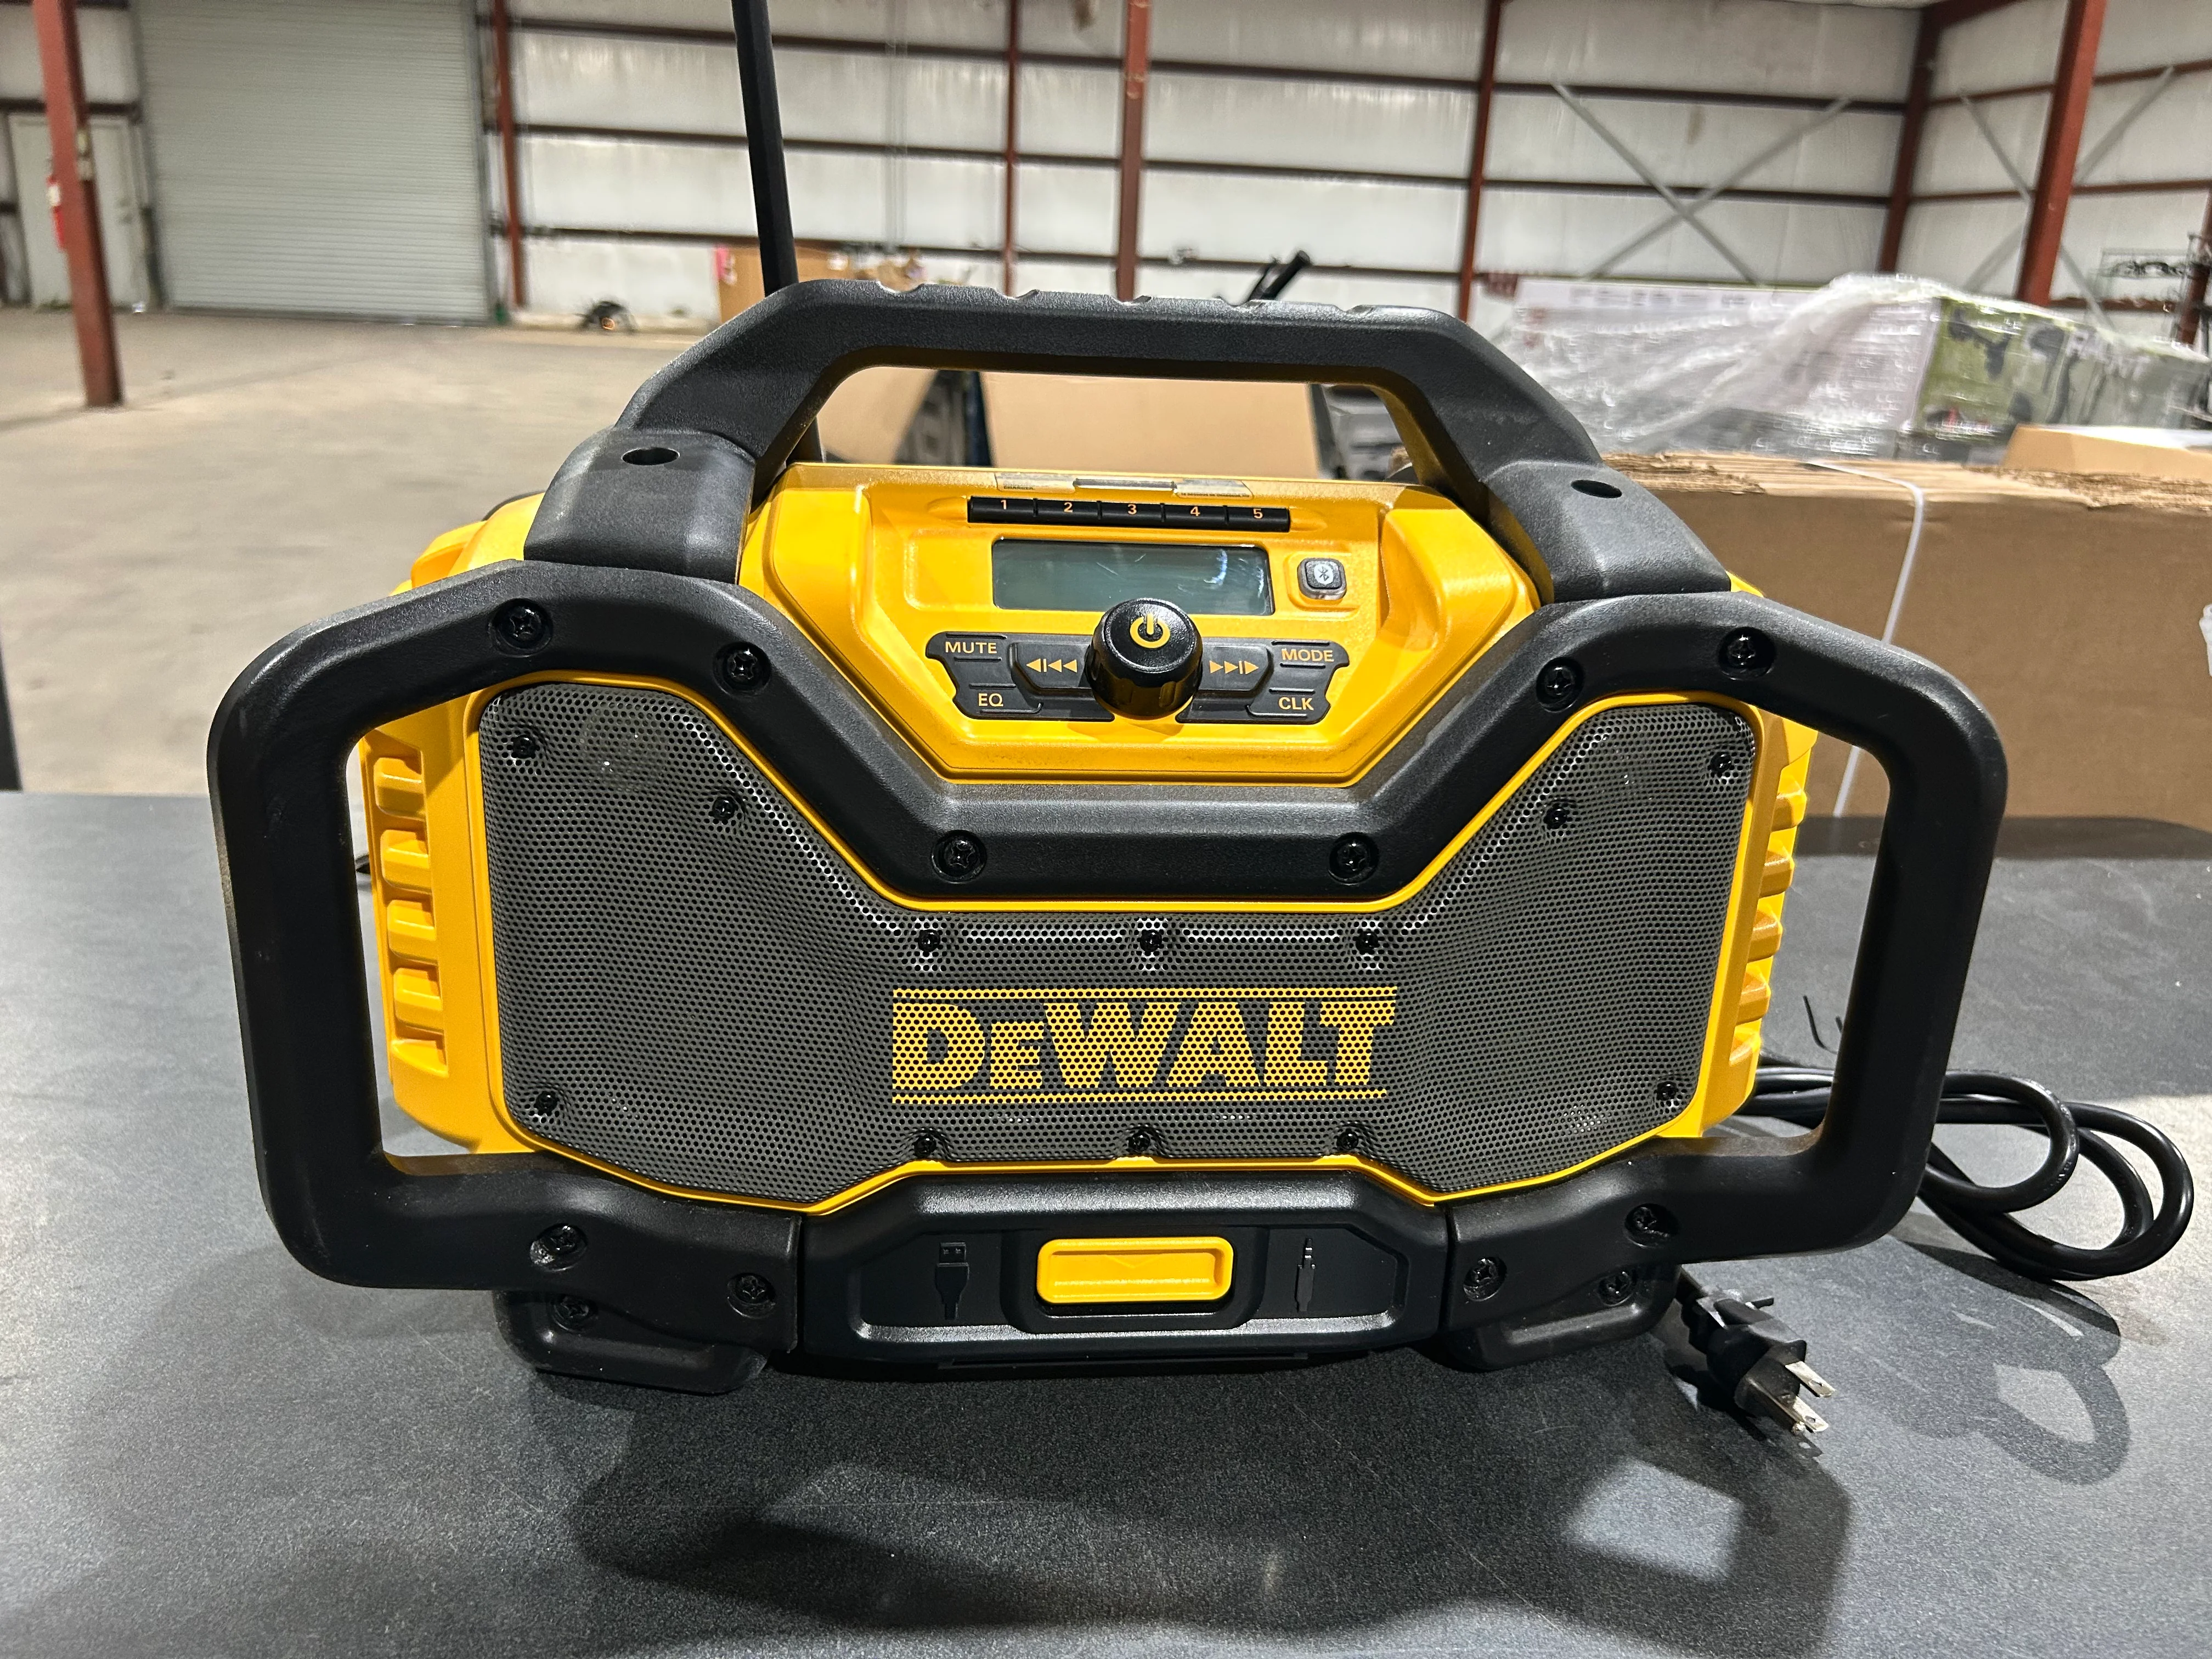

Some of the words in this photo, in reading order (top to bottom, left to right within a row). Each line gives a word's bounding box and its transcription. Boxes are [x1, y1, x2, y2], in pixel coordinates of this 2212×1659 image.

[1000, 499, 1007, 510] 1
[1063, 501, 1074, 513] 2
[1127, 504, 1137, 515] 3
[1190, 506, 1201, 517] 4
[1252, 508, 1263, 519] 5
[944, 641, 997, 655] MUTE
[1281, 648, 1334, 663] MODE
[978, 692, 1005, 708] EQ
[1278, 696, 1314, 712] CLK
[892, 1001, 1397, 1091] DEWALT
